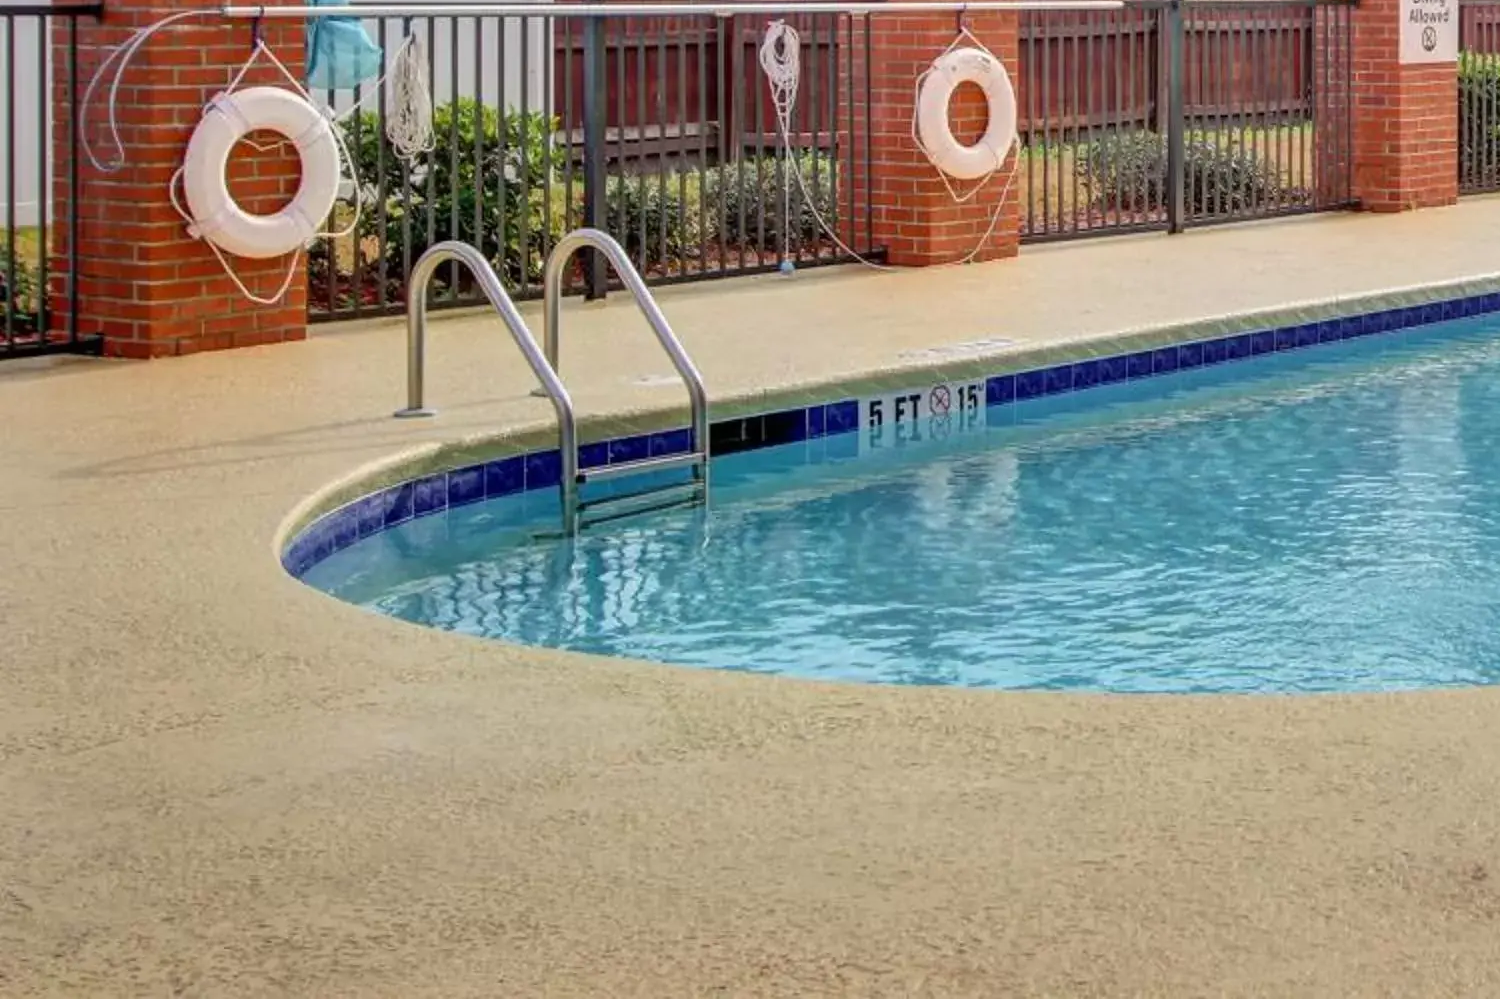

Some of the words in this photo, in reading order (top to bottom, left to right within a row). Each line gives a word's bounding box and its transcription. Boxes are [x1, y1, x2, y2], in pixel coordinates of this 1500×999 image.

[1409, 8, 1449, 23] Allowed
[869, 400, 882, 427] 5
[895, 394, 921, 422] FT
